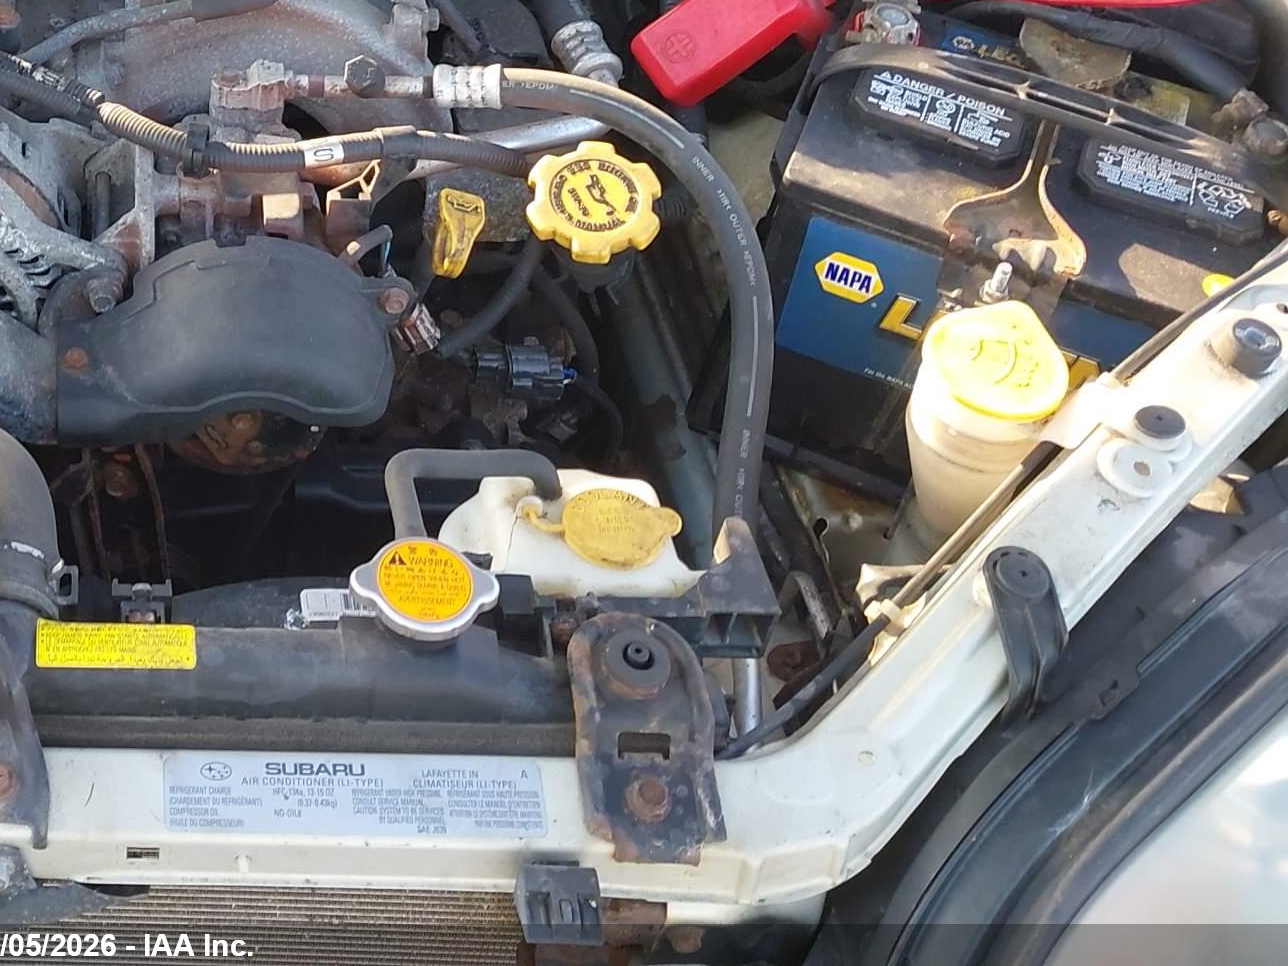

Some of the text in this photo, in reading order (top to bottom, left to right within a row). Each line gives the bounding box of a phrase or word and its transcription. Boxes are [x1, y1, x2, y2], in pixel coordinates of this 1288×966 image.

[893, 74, 946, 98] DANGER
[957, 94, 1006, 118] POISON
[313, 148, 334, 162] S
[692, 156, 715, 184] INNER
[729, 213, 747, 248] OUTER
[823, 262, 873, 295] NAPA
[408, 555, 454, 569] WARNING
[265, 763, 365, 777] SUBARU
[421, 769, 478, 779] LAFAYETTE IN
[520, 769, 528, 779] A
[241, 777, 384, 789] AIR CONDITIONER (LI-TYPE)
[412, 778, 474, 789] CLIMATISEUR
